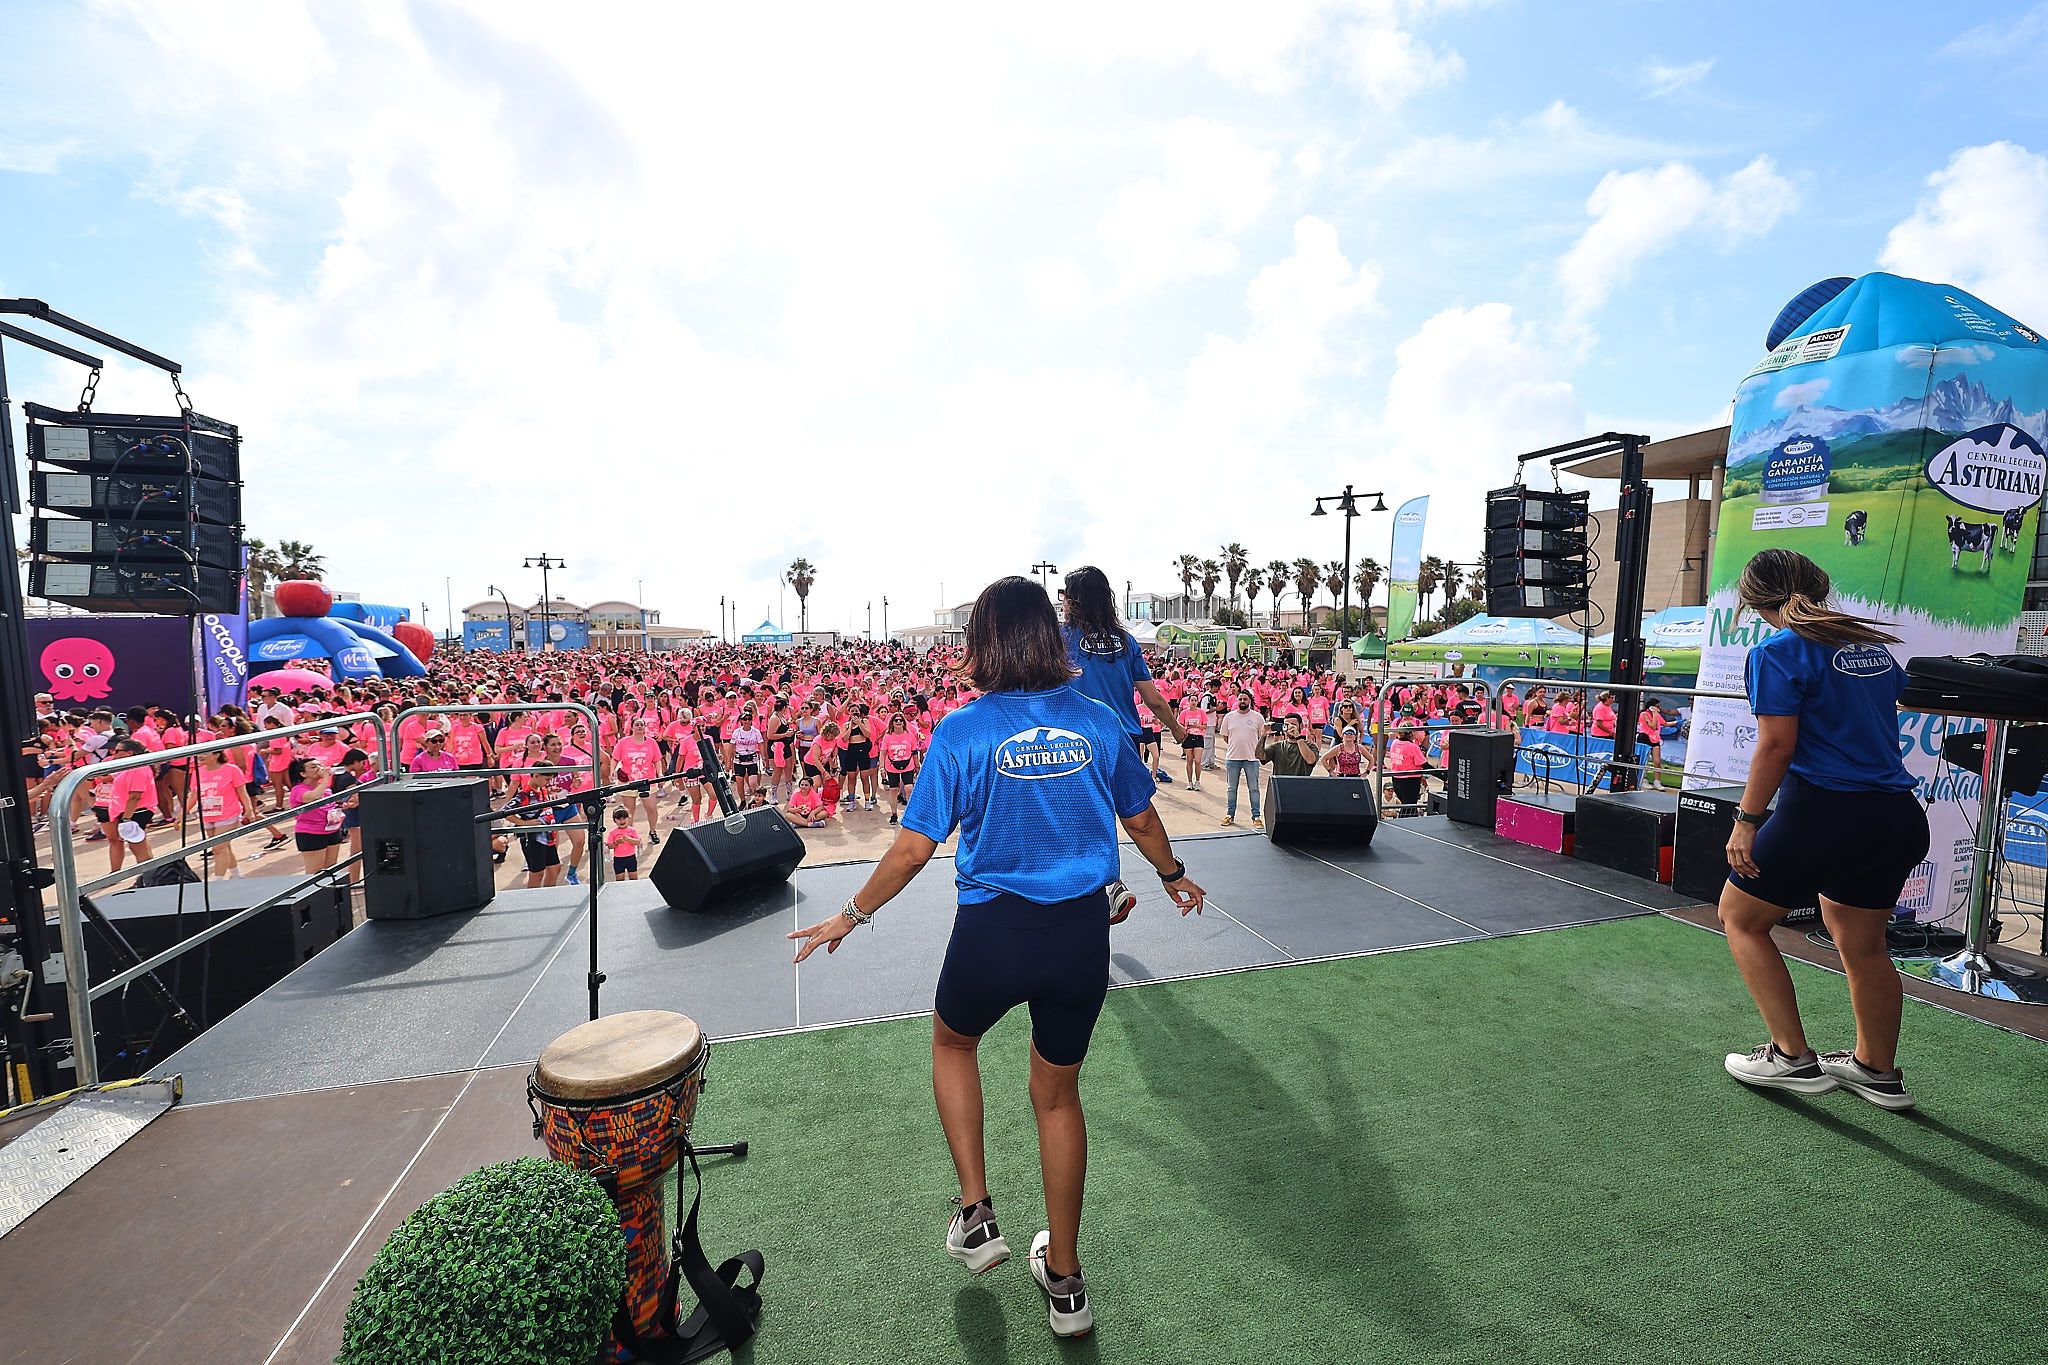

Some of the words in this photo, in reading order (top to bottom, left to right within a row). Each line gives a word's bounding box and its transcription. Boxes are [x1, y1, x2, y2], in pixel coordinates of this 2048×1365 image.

[1771, 454, 1823, 469] GARANTÍA
[1967, 451, 2007, 464] CENTRAL
[2008, 456, 2042, 470] LECHERA
[1767, 464, 1824, 478] GANADERA
[1936, 450, 2041, 496] ASTURIANA
[1768, 481, 1790, 489] CONFORT
[1799, 478, 1821, 486] GANADO
[203, 614, 247, 676] octopus
[1840, 655, 1891, 670] ASTURIANA
[214, 656, 240, 686] energy
[1015, 745, 1047, 753] CENTRAL
[1050, 741, 1084, 749] LECHERA
[1001, 748, 1087, 770] ASTURIANA
[1457, 758, 1466, 799] portos
[1680, 797, 1716, 811] portos
[1953, 839, 1970, 847] JUNTOS
[1954, 854, 1973, 862] ALIMENT
